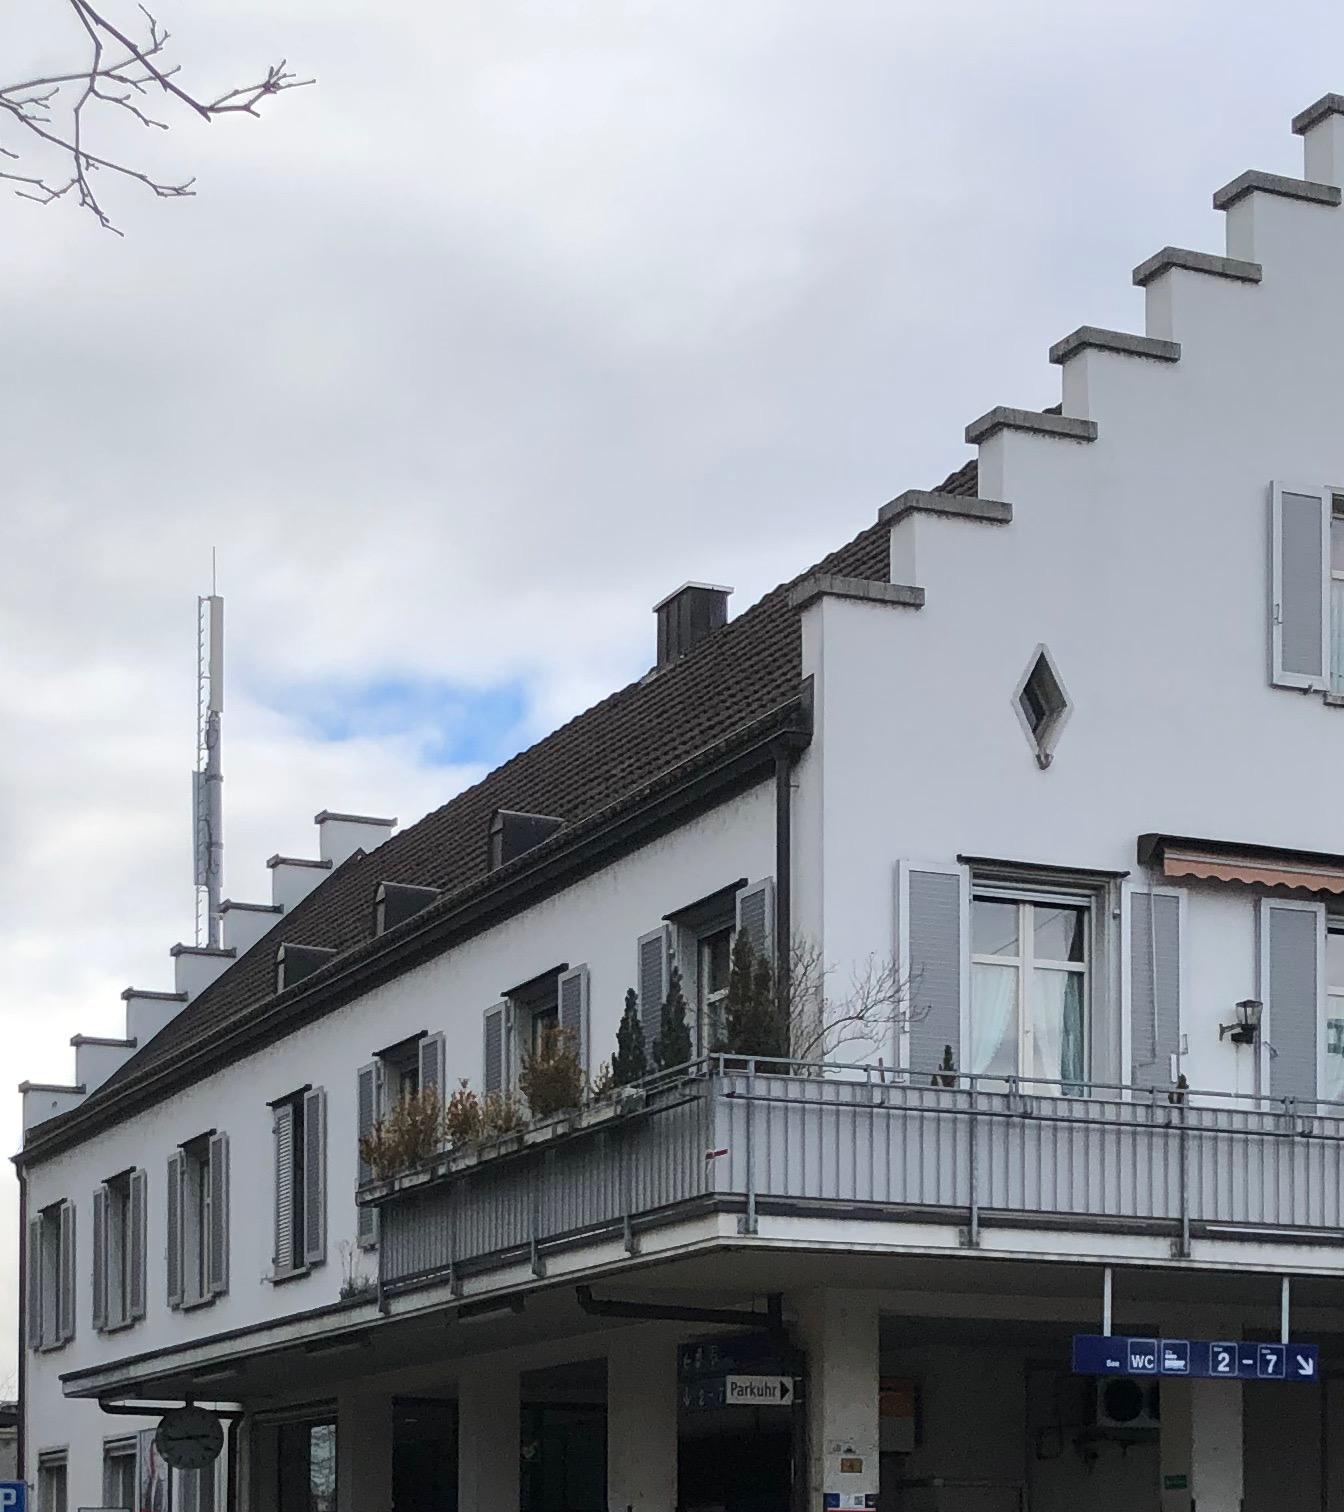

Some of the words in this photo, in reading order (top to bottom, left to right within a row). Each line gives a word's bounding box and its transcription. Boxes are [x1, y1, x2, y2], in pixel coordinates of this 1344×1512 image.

[1131, 1354, 1154, 1369] WC
[1217, 1352, 1230, 1372] 2
[1266, 1354, 1277, 1374] 7
[730, 1382, 778, 1398] Parkuhr
